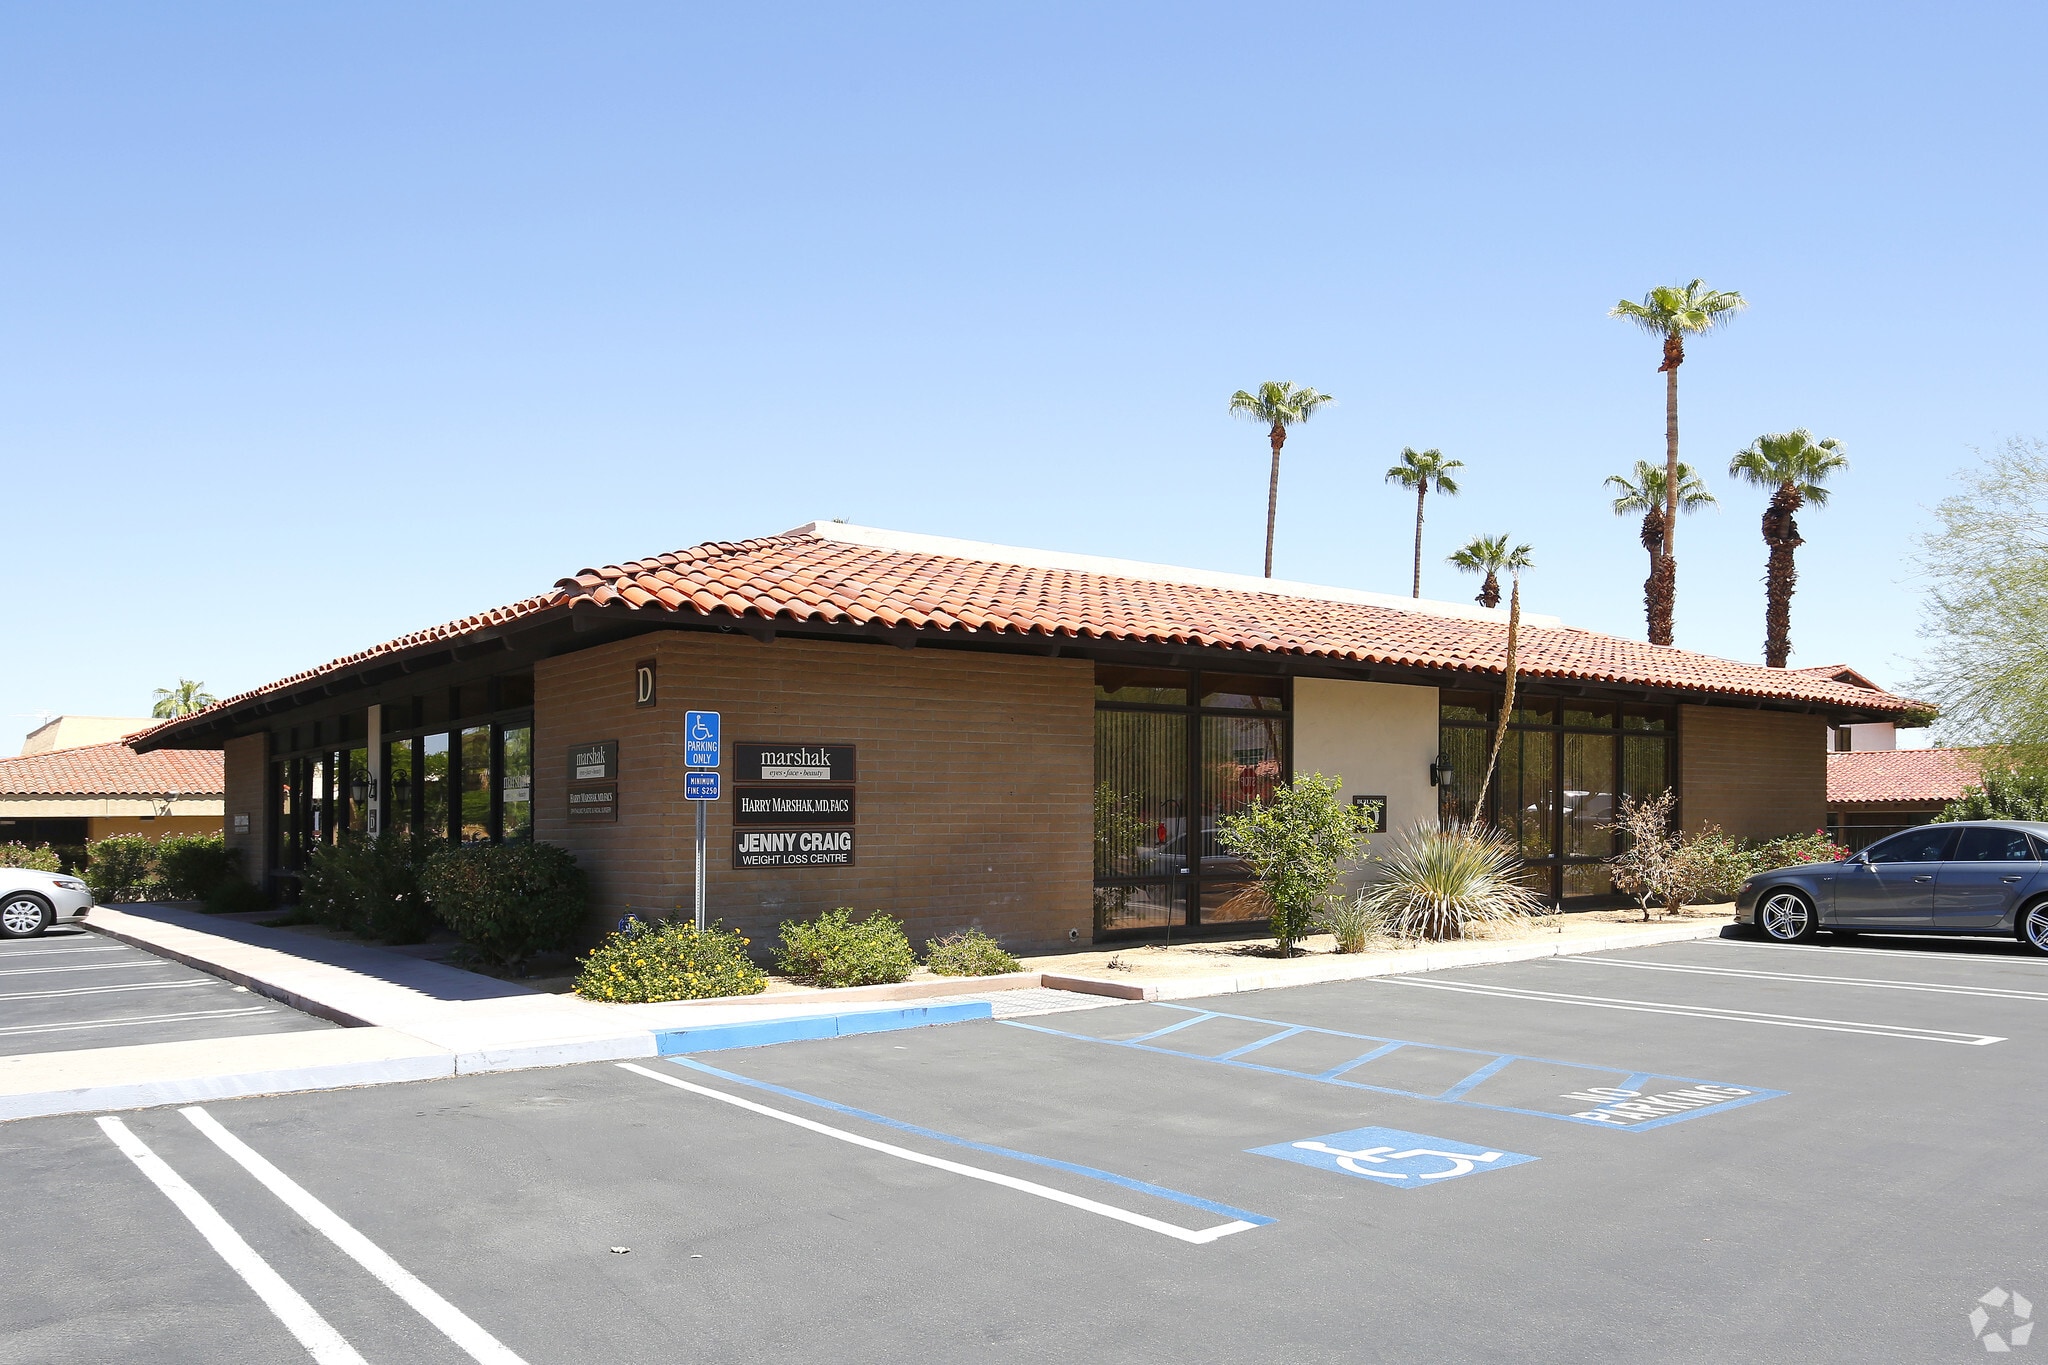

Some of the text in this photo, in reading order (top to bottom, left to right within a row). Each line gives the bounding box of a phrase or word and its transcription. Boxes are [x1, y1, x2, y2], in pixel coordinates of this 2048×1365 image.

[638, 667, 652, 702] D
[688, 741, 717, 752] PARKING
[576, 746, 605, 765] marshak
[693, 754, 711, 764] ONLY
[761, 748, 831, 766] marshak
[785, 769, 799, 777] face
[742, 797, 771, 812] HARRY
[772, 797, 814, 813] MARSHAK,
[739, 832, 851, 852] JENNY CRAIG
[742, 853, 847, 865] WEIGHT LOSS CENTRE
[1559, 1087, 1642, 1104] NO
[1569, 1084, 1752, 1125] PARKING
